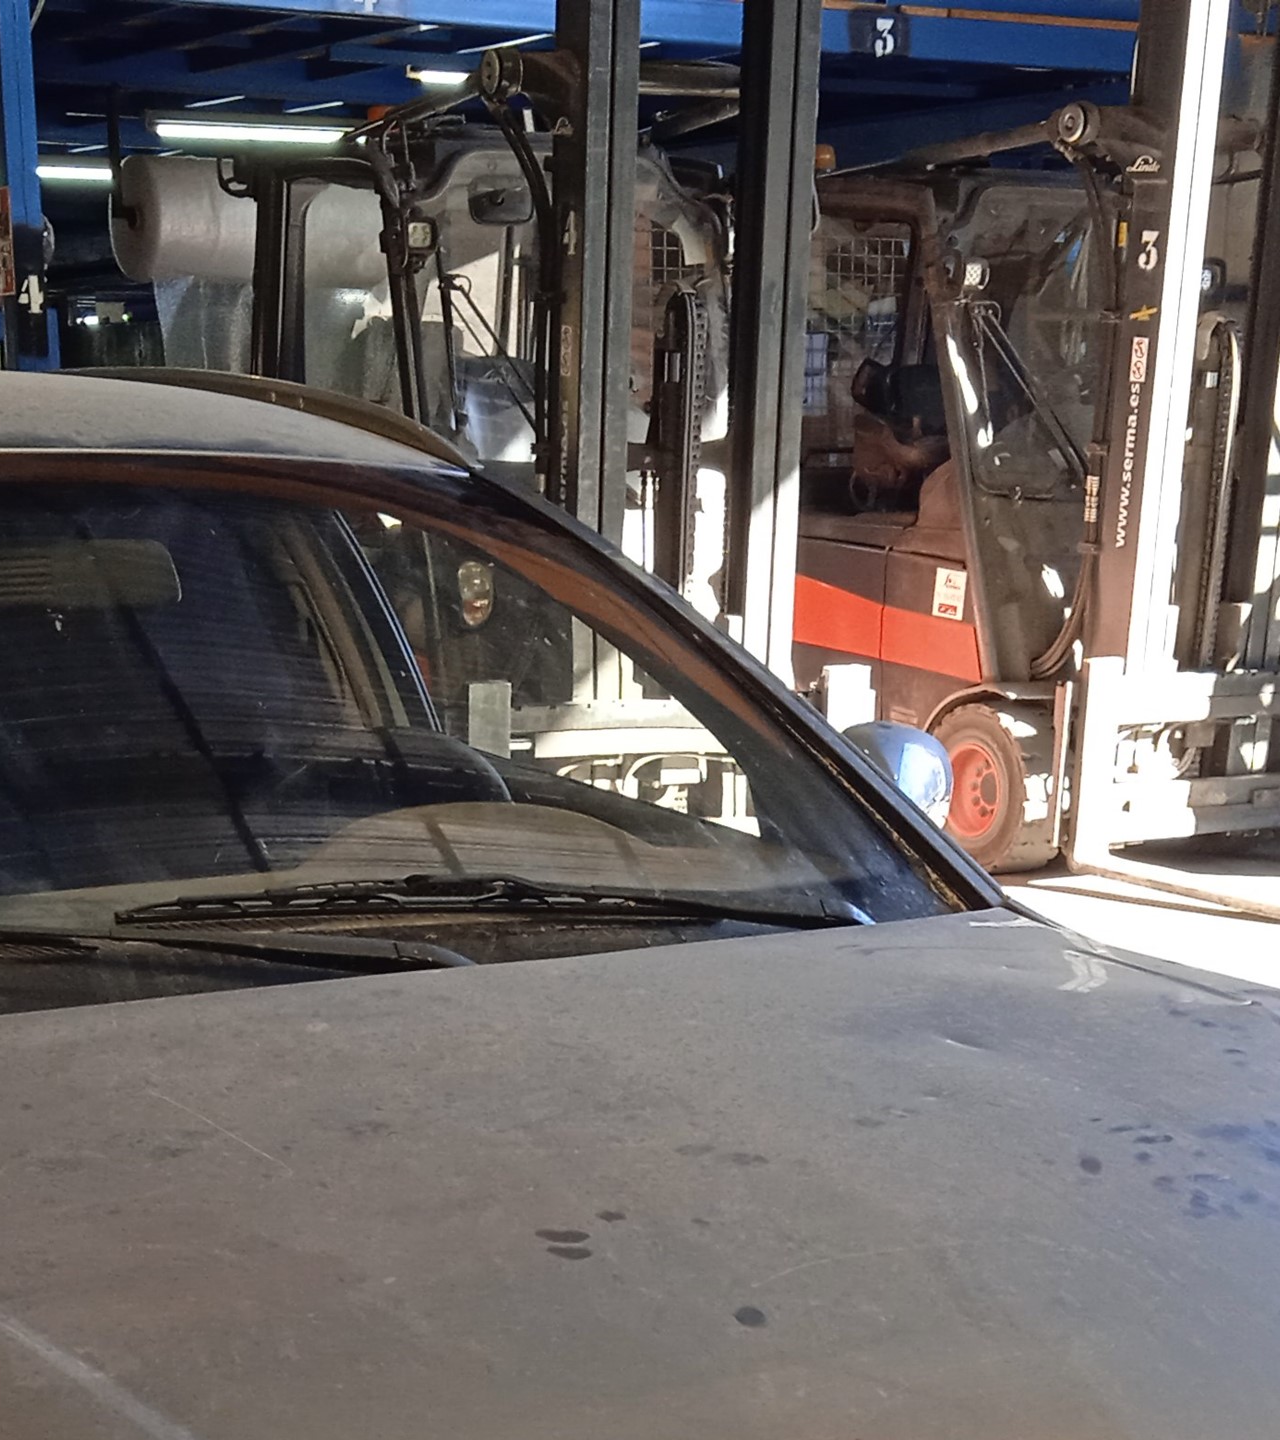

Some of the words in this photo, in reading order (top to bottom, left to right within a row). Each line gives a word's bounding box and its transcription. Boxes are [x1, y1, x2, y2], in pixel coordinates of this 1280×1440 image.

[874, 17, 895, 58] 3
[1126, 155, 1161, 172] Linde
[562, 210, 577, 256] 4
[1138, 230, 1160, 271] 3
[18, 274, 44, 314] 4
[1115, 383, 1141, 548] www.serma.es
